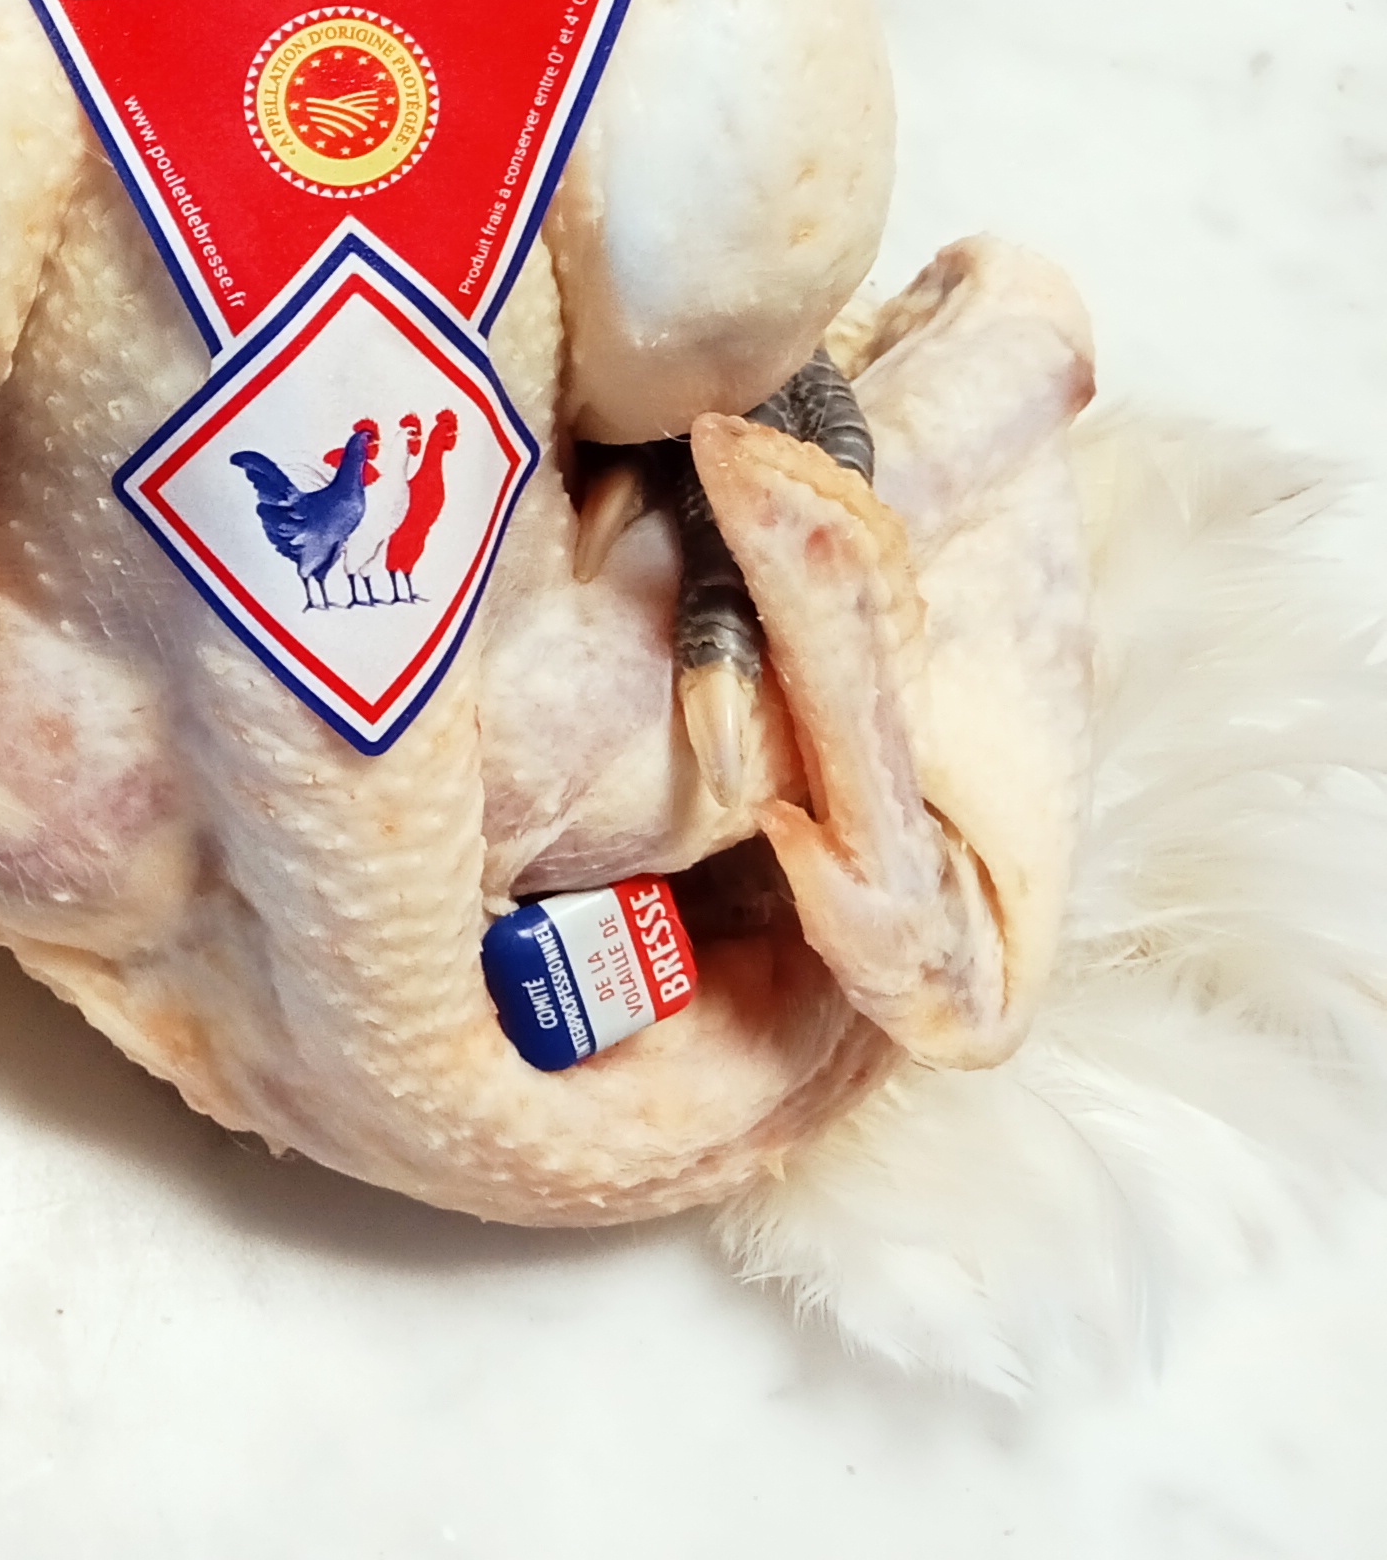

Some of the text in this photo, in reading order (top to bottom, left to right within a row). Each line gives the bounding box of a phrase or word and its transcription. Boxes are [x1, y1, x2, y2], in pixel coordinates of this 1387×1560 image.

[263, 26, 423, 149] APPELLATION D'ORIGINE PROTÉGÉE
[123, 95, 247, 308] www.pouletdebresse.fr
[458, 238, 494, 295] Produit
[481, 200, 507, 236] frais
[504, 109, 541, 185] conserver
[533, 65, 560, 106] entre
[559, 28, 575, 44] et
[522, 975, 558, 1030] COMITÉ
[532, 920, 591, 1060] INTERPROFESSIONNEL
[587, 949, 616, 1003] DE LA
[598, 913, 644, 1018] VOLAILLE DE
[629, 883, 691, 1004] BRESSE
